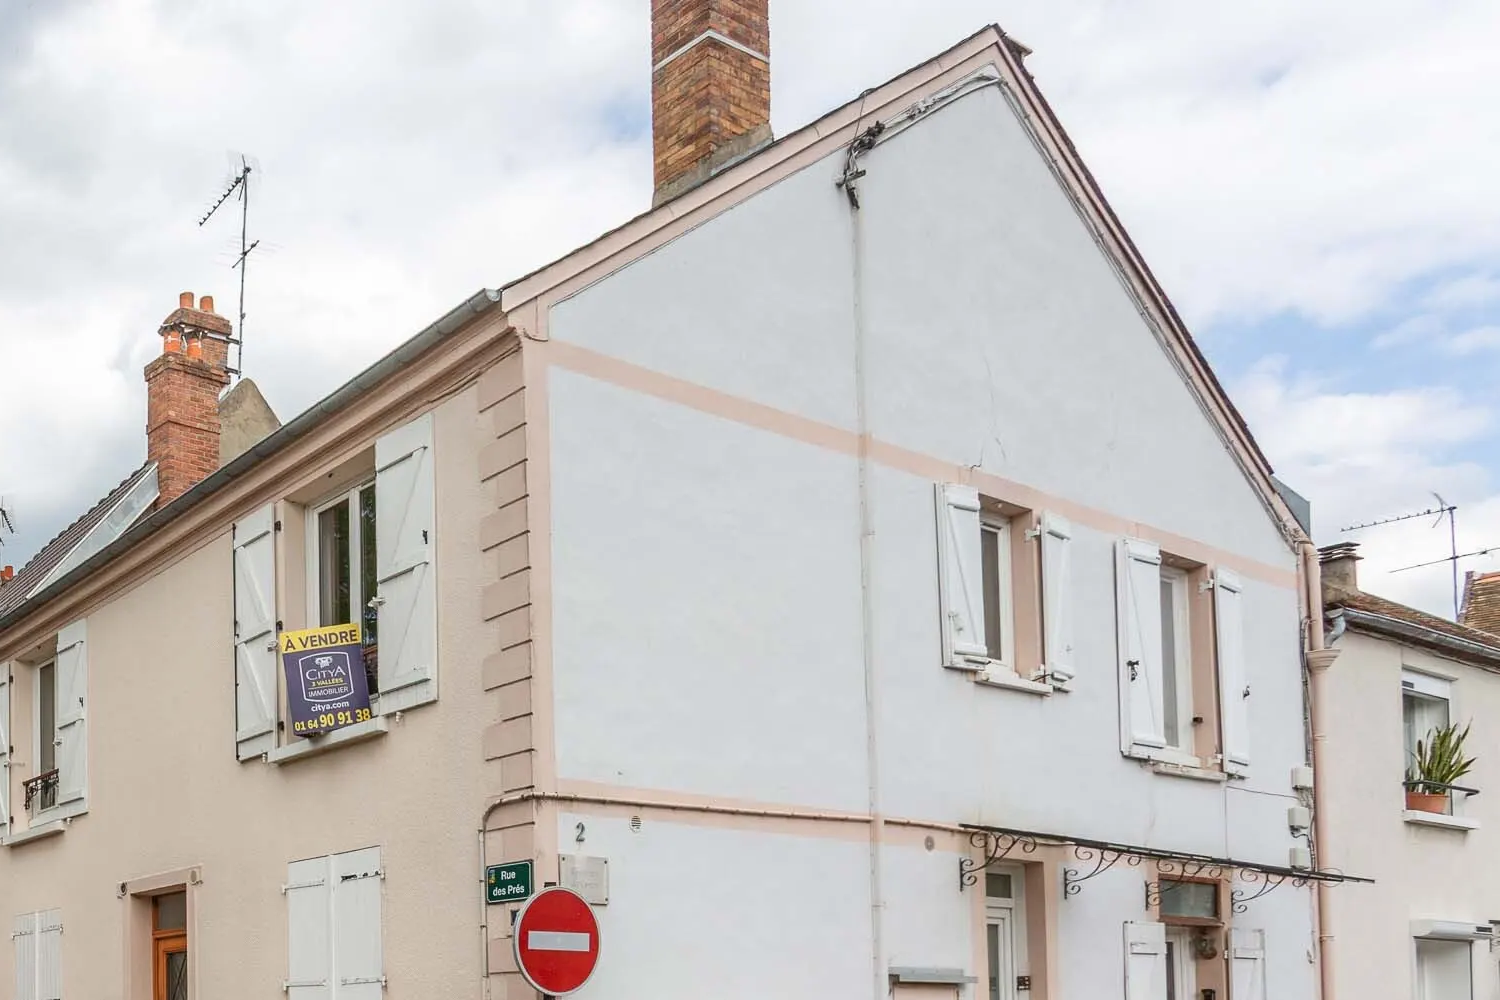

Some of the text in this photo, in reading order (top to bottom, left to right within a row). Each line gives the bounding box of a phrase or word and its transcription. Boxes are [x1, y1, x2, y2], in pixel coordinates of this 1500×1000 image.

[284, 629, 358, 652] À VENDRE
[308, 686, 349, 697] IMMOBILIER
[311, 701, 350, 712] citya.com
[294, 708, 371, 732] 01 64 90 91 38
[575, 822, 586, 842] 2
[501, 870, 516, 880] Rue
[492, 883, 525, 896] des Prés
